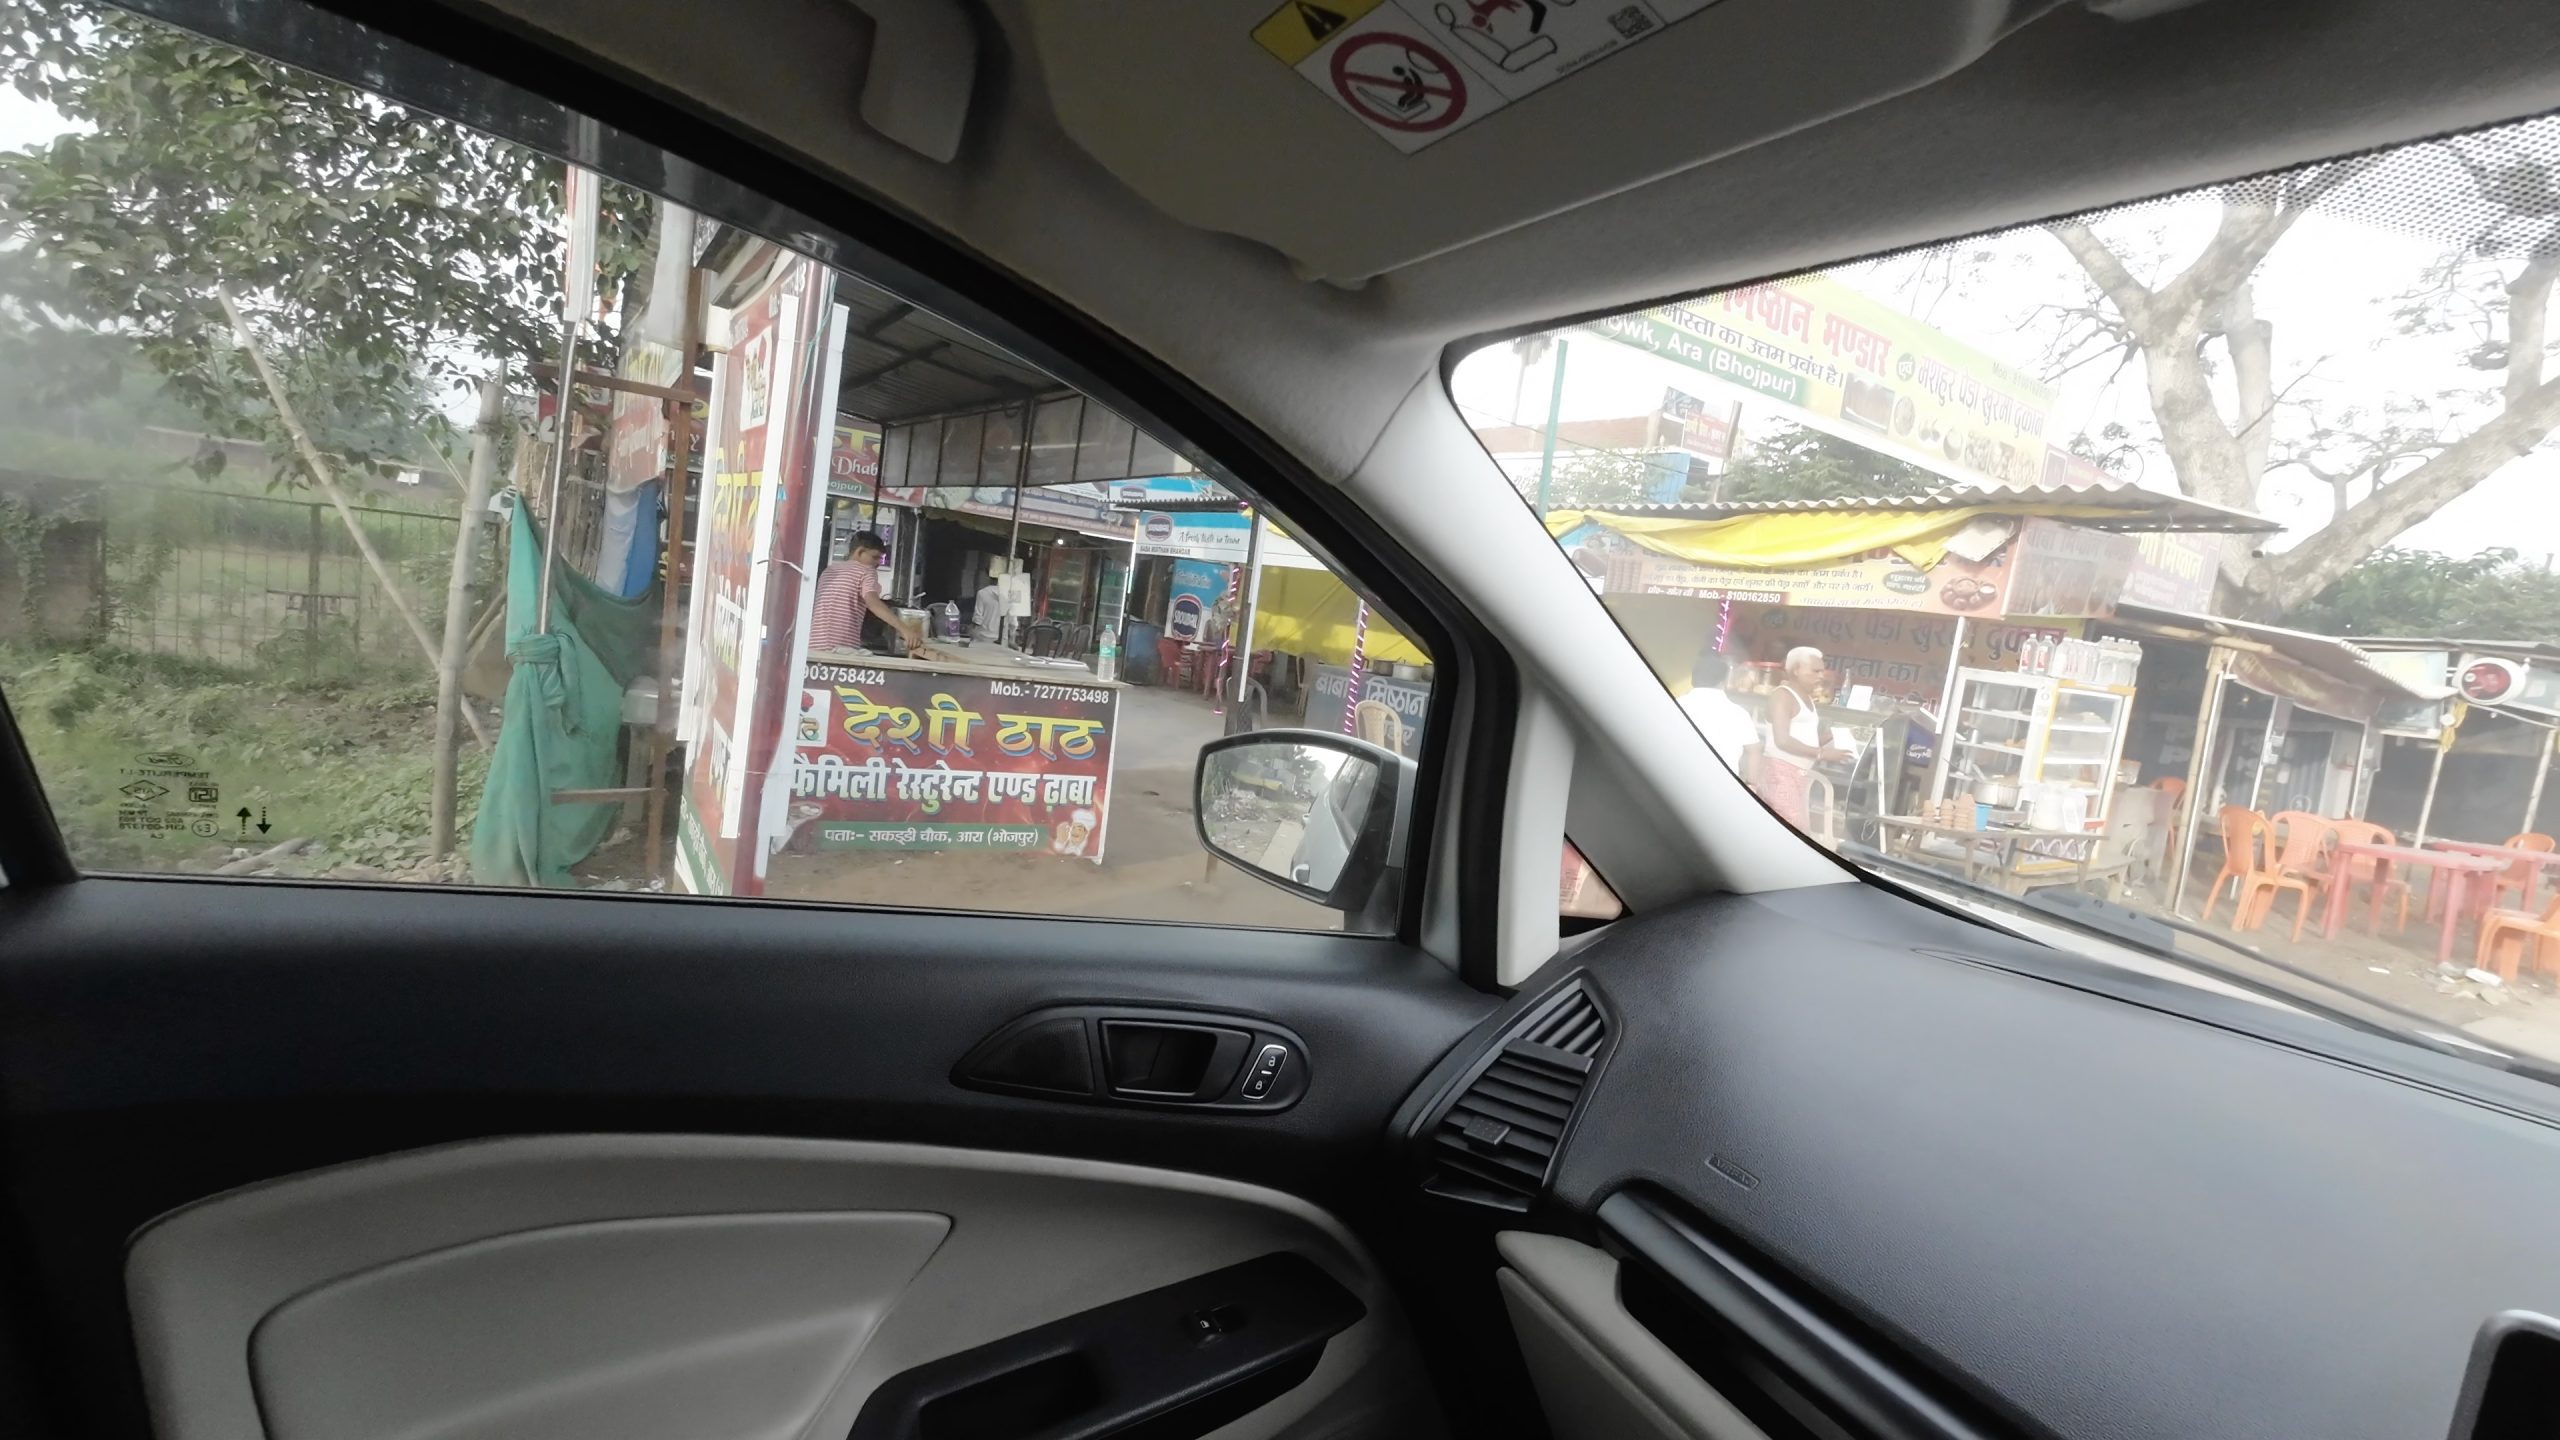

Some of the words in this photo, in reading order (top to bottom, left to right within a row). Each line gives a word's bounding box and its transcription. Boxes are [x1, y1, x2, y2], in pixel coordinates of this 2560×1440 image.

[1719, 327, 1743, 347] का
[1667, 332, 1701, 361] Ara
[1709, 347, 1797, 399] (Bhojpur)
[832, 456, 878, 476] Dhab
[828, 481, 862, 494] ojpur)
[1033, 684, 1109, 704] 7277753498
[834, 686, 985, 757] देशी
[996, 713, 1105, 761] ठाठ
[986, 770, 1041, 804] एण्ड
[957, 829, 982, 843] आरा
[988, 827, 1039, 846] (भोजपुर)
